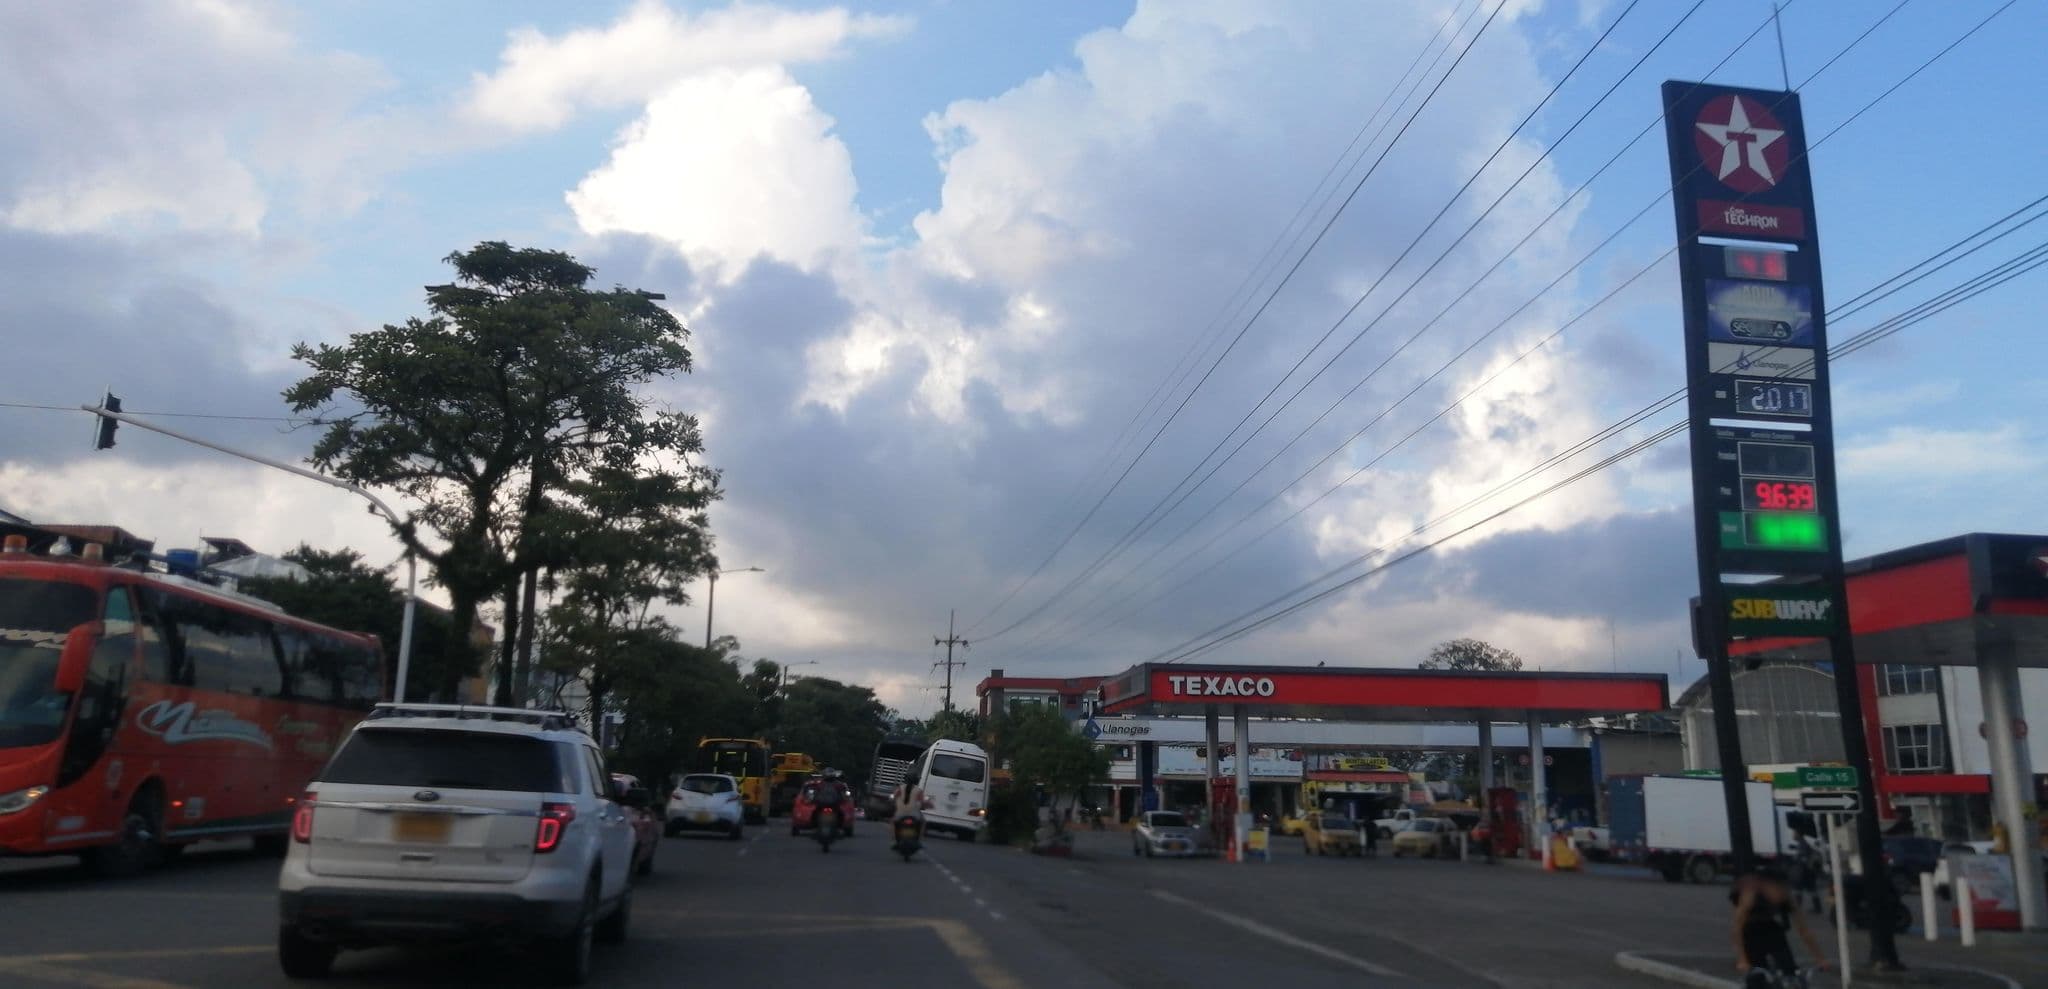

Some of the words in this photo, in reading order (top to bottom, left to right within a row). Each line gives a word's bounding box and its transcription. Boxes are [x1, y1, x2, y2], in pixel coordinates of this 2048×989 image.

[1724, 211, 1778, 230] TECHRON
[1731, 598, 1832, 620] SUBWAY
[1169, 676, 1275, 697] TEXACO
[1102, 723, 1152, 736] Llanogas
[1806, 771, 1832, 782] Calle
